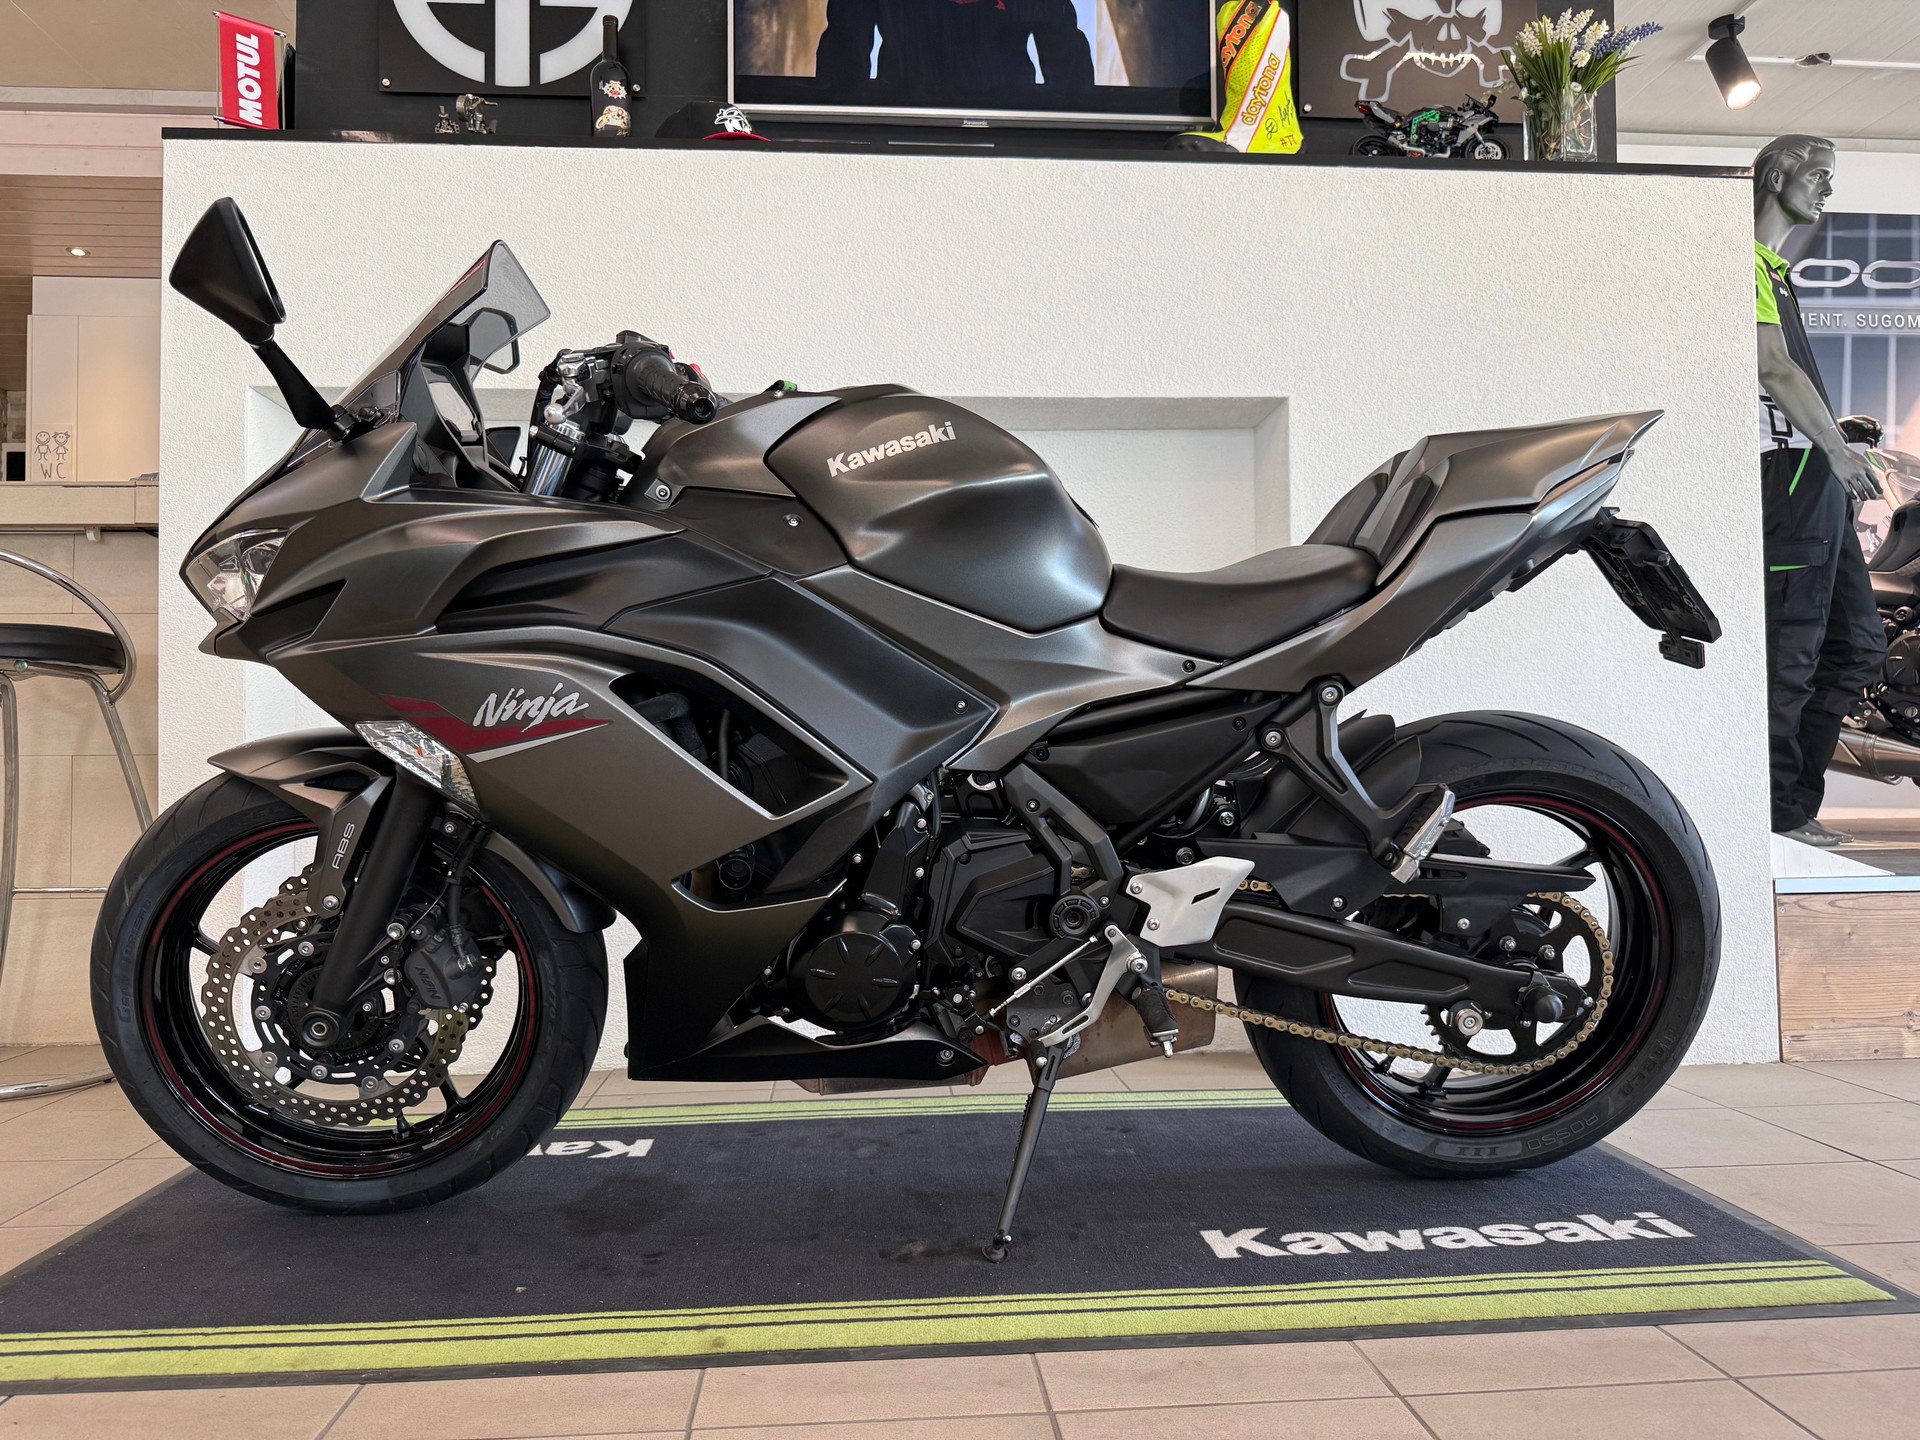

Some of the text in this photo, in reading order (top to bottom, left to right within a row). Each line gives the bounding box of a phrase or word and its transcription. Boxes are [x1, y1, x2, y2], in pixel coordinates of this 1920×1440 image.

[1221, 1, 1262, 68] aytona
[235, 32, 263, 126] MOTUL
[1241, 53, 1280, 126] daytona
[1856, 313, 1920, 328] SUGOM
[826, 421, 957, 477] Kawasaki
[472, 682, 590, 733] Ninja
[331, 822, 355, 869] ABS
[1526, 1112, 1599, 1151] ROSSO
[1199, 1211, 1696, 1259] Kawasaki
